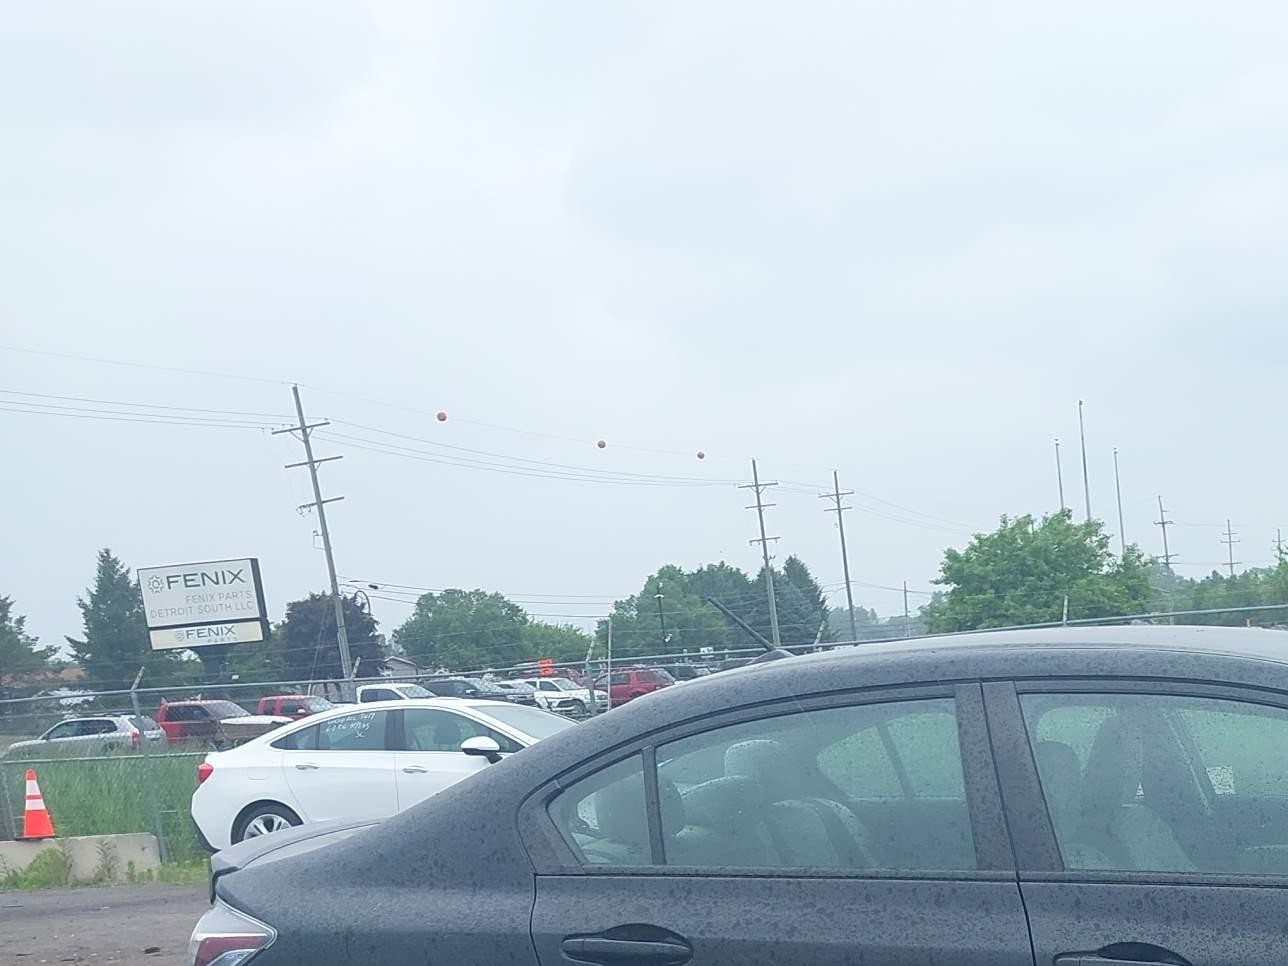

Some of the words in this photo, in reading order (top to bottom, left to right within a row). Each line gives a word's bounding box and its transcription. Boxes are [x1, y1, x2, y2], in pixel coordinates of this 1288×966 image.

[166, 568, 246, 590] FENIX
[186, 593, 217, 604] FENIX
[219, 590, 252, 601] PARTS
[150, 607, 193, 618] DETROIT
[198, 603, 232, 614] SOUTH
[235, 600, 254, 611] LLC
[185, 625, 236, 639] FENIX
